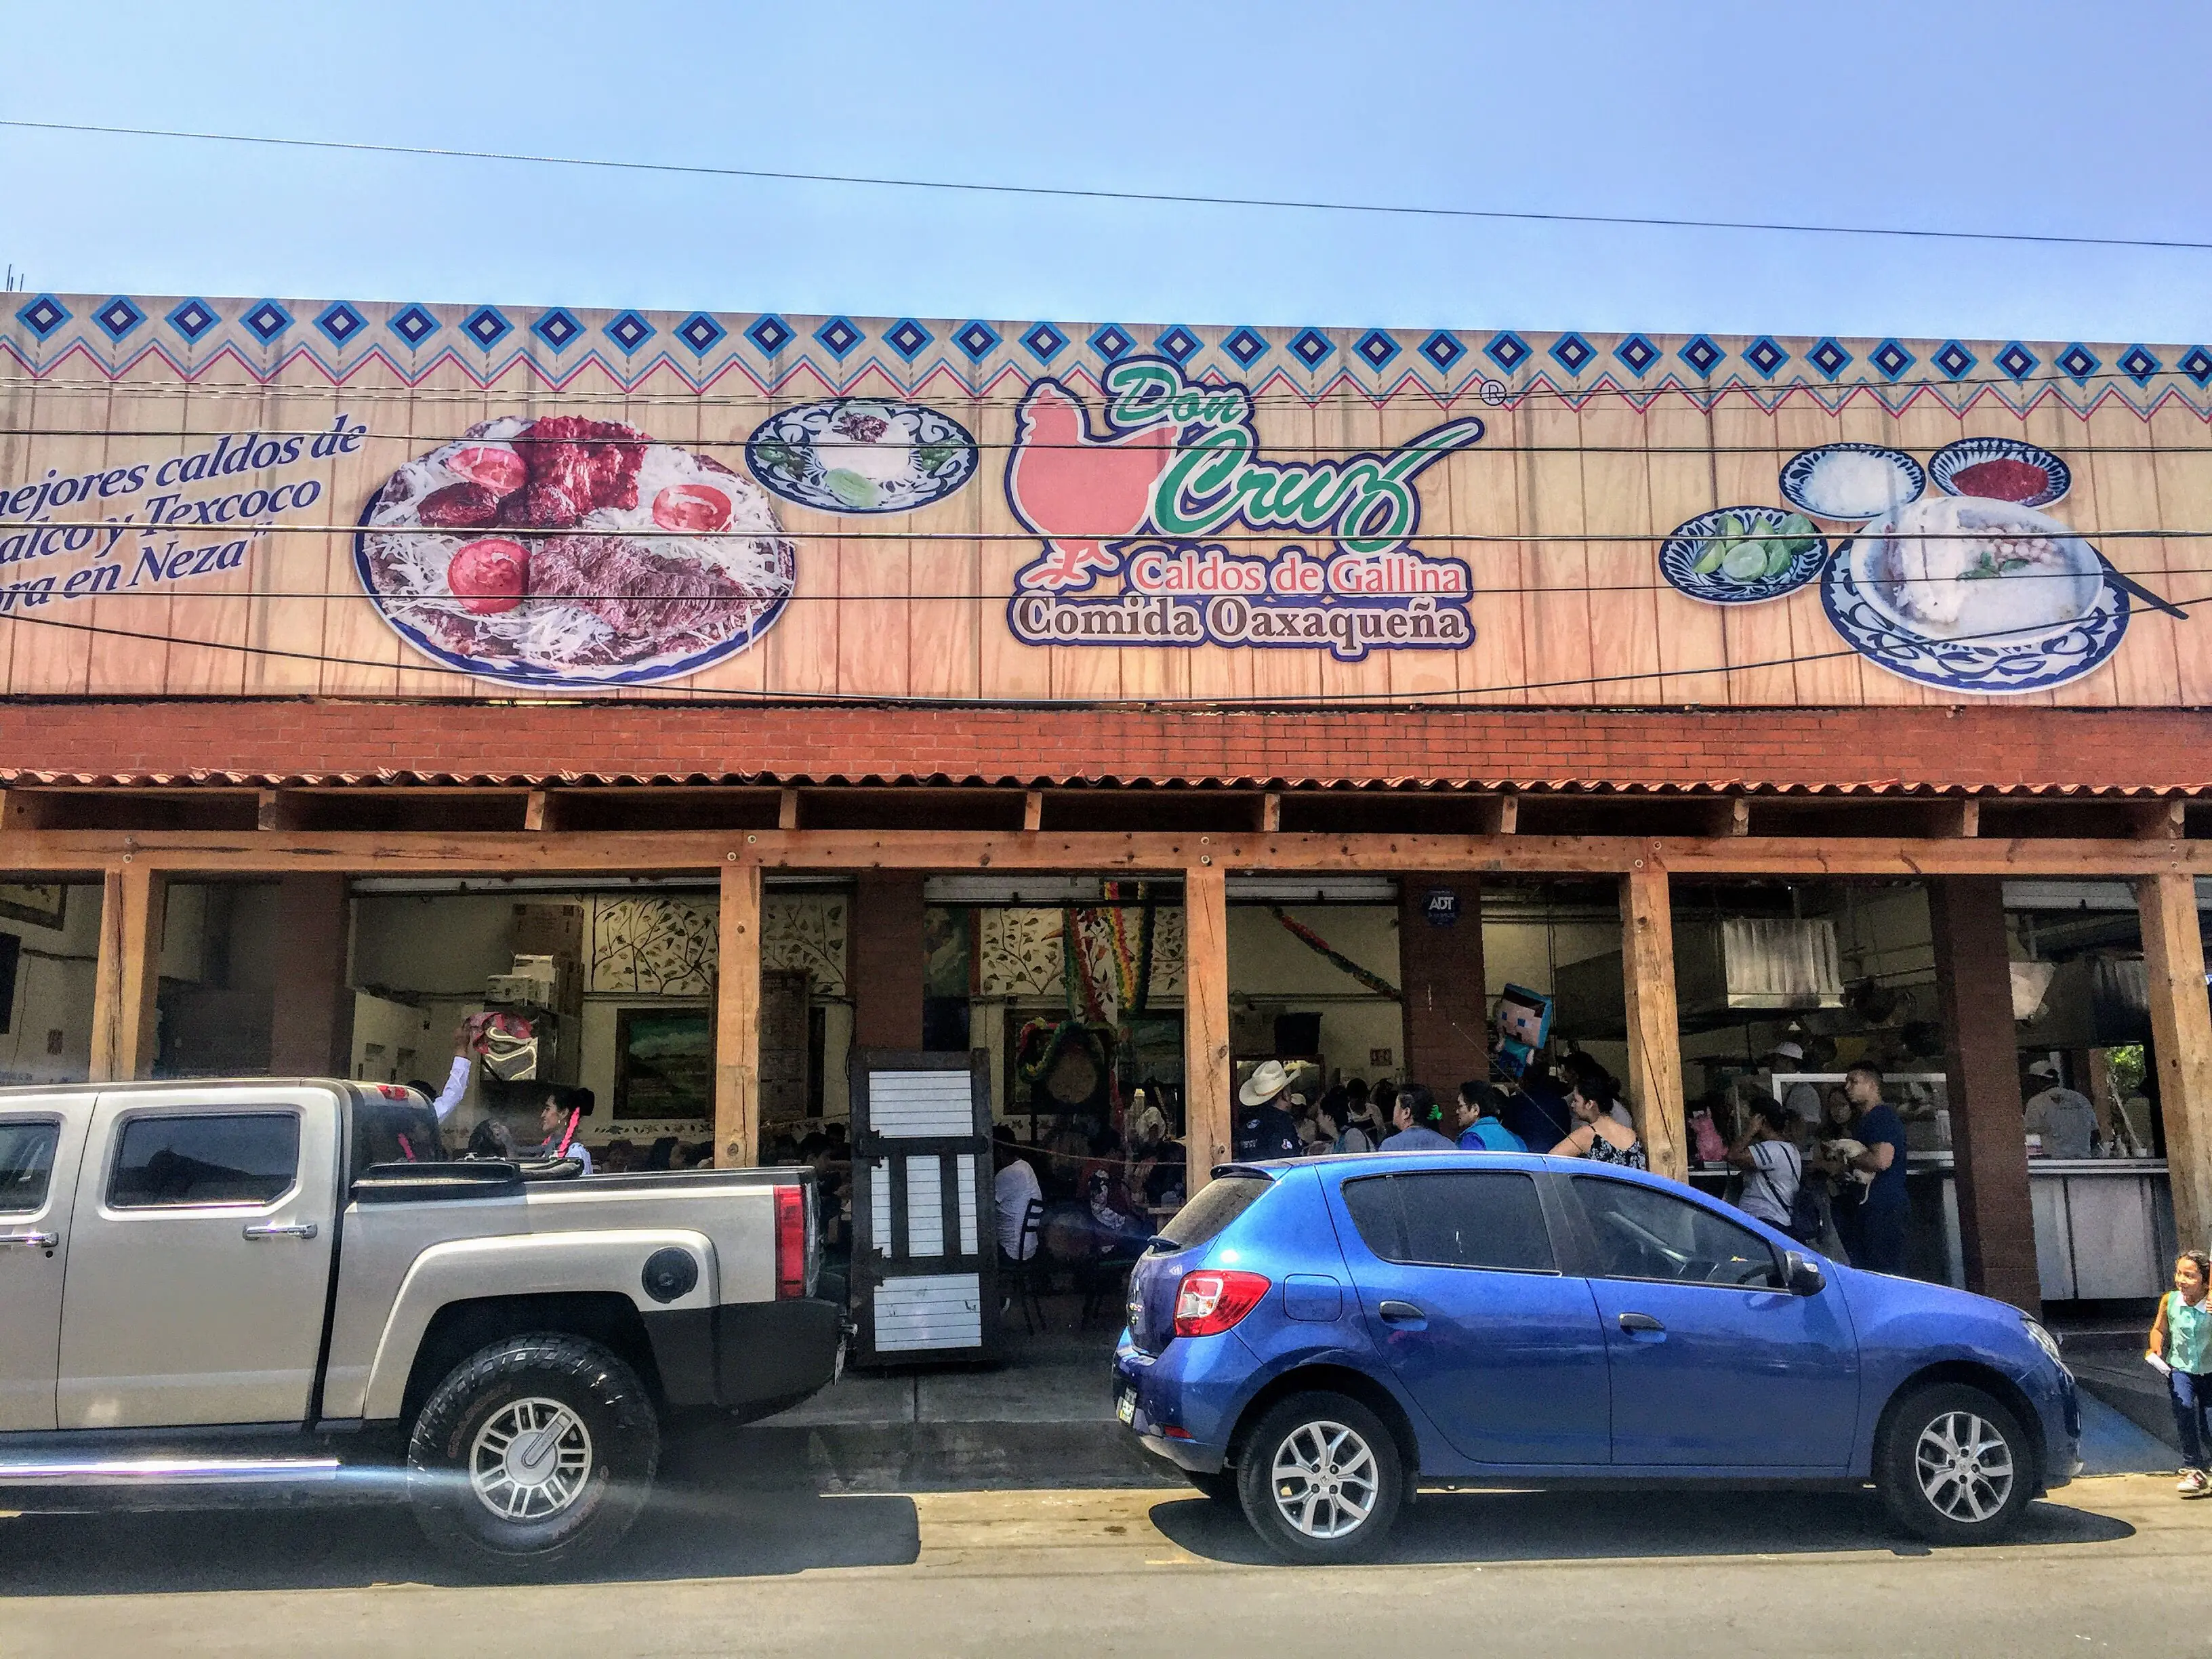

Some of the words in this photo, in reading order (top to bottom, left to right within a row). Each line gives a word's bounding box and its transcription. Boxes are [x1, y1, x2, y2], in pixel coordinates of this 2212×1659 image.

[1113, 366, 1244, 424] Don
[155, 430, 304, 487] caldos
[310, 413, 367, 459] de
[1155, 423, 1479, 552] Cruz
[94, 513, 135, 559] y
[140, 479, 321, 538] Texcoco
[63, 563, 122, 599] en
[1134, 556, 1262, 593] Caldos
[1275, 558, 1324, 593] de
[1332, 556, 1462, 594] Gallina
[1019, 596, 1197, 637] Comida
[1211, 596, 1465, 650] Oaxaqueña
[1428, 896, 1454, 910] ADT
